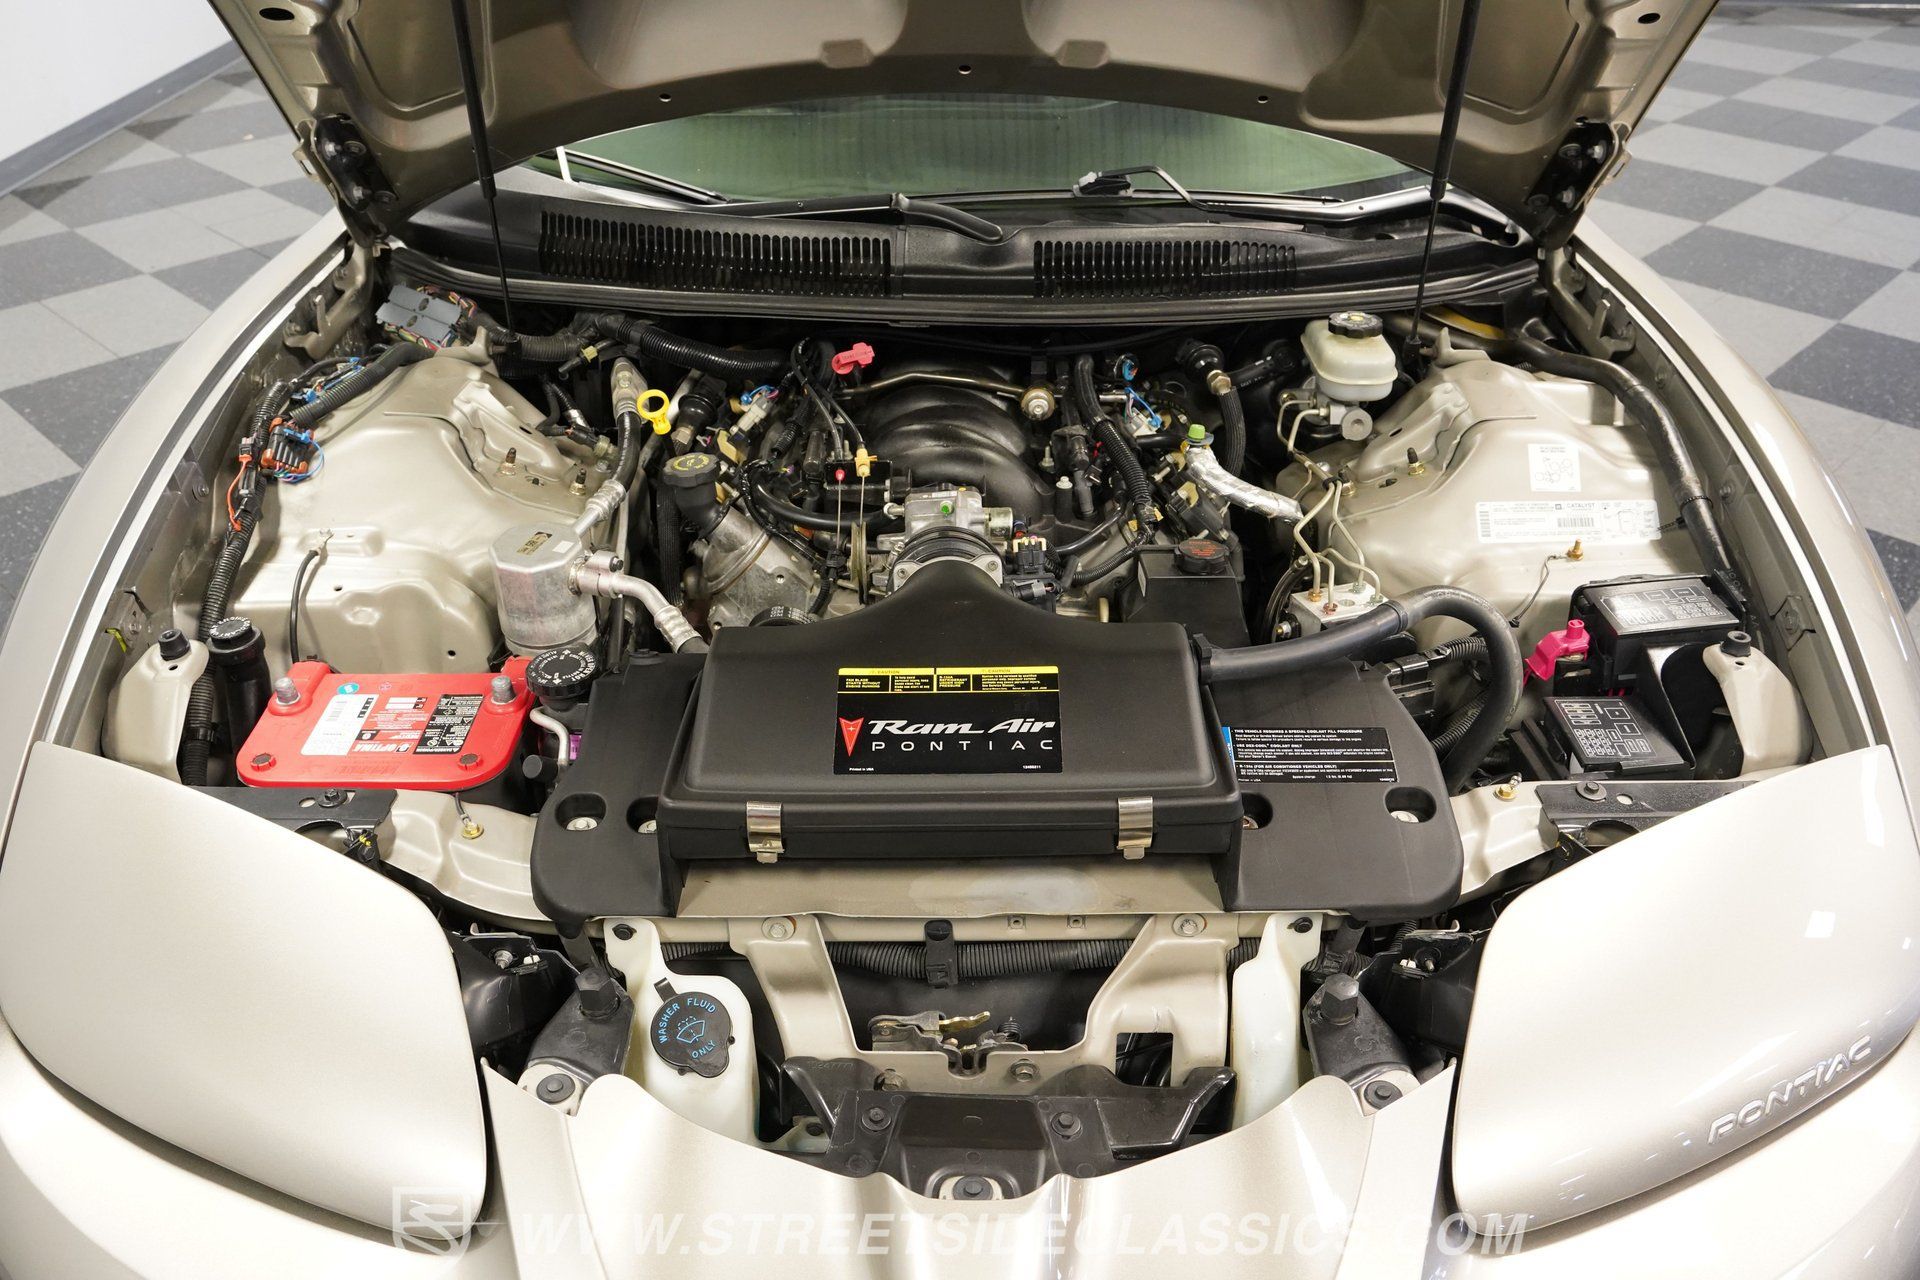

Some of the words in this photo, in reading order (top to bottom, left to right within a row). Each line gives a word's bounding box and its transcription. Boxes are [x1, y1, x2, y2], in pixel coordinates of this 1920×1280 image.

[868, 720, 985, 734] Ram
[987, 718, 1056, 734] Air
[872, 740, 1053, 751] PONTIAC
[658, 1003, 680, 1043] WASHER
[687, 998, 716, 1013] FLUID
[691, 1040, 716, 1058] ONLY
[1708, 1035, 1872, 1145] PONTIAC
